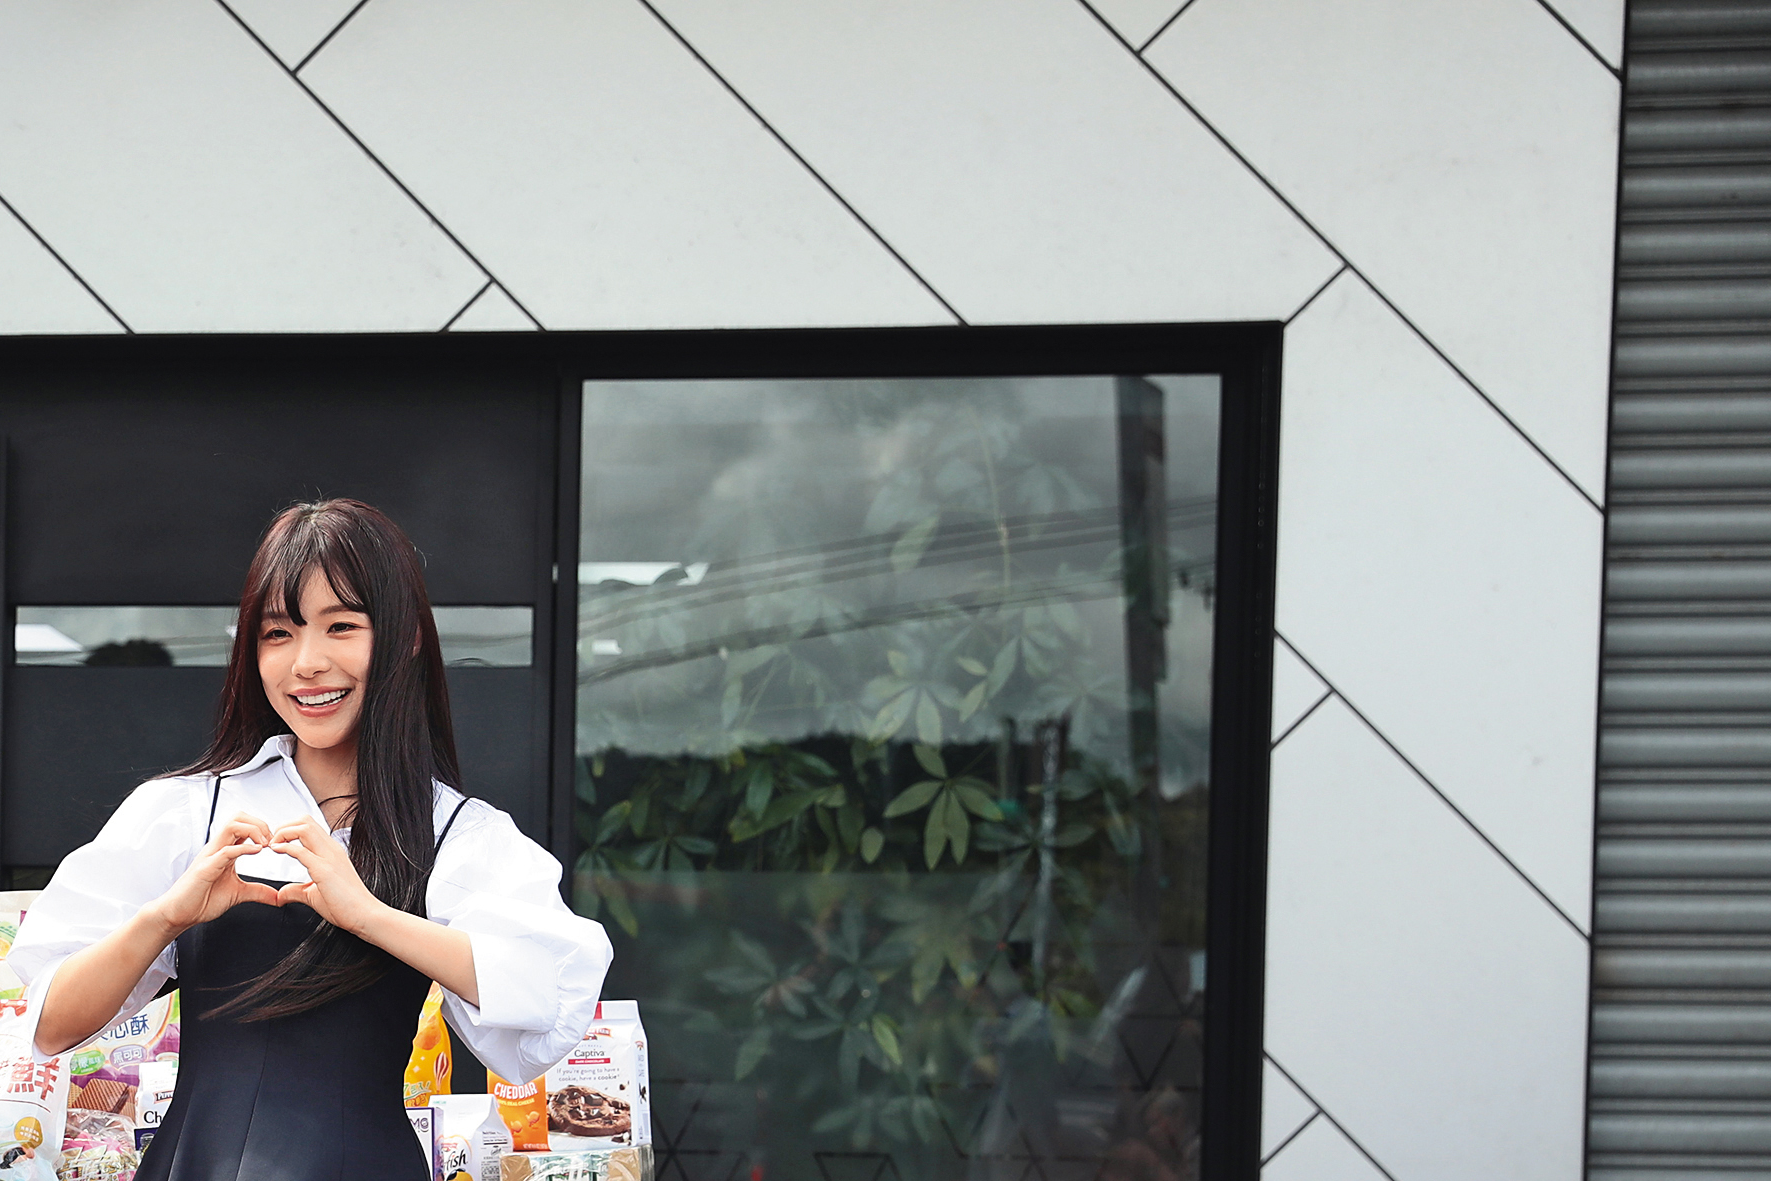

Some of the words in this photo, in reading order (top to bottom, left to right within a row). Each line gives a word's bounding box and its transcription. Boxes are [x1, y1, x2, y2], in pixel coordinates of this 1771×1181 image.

[574, 1049, 605, 1059] Captiva
[494, 1082, 538, 1100] CHEDDAR
[144, 1110, 163, 1124] Ch
